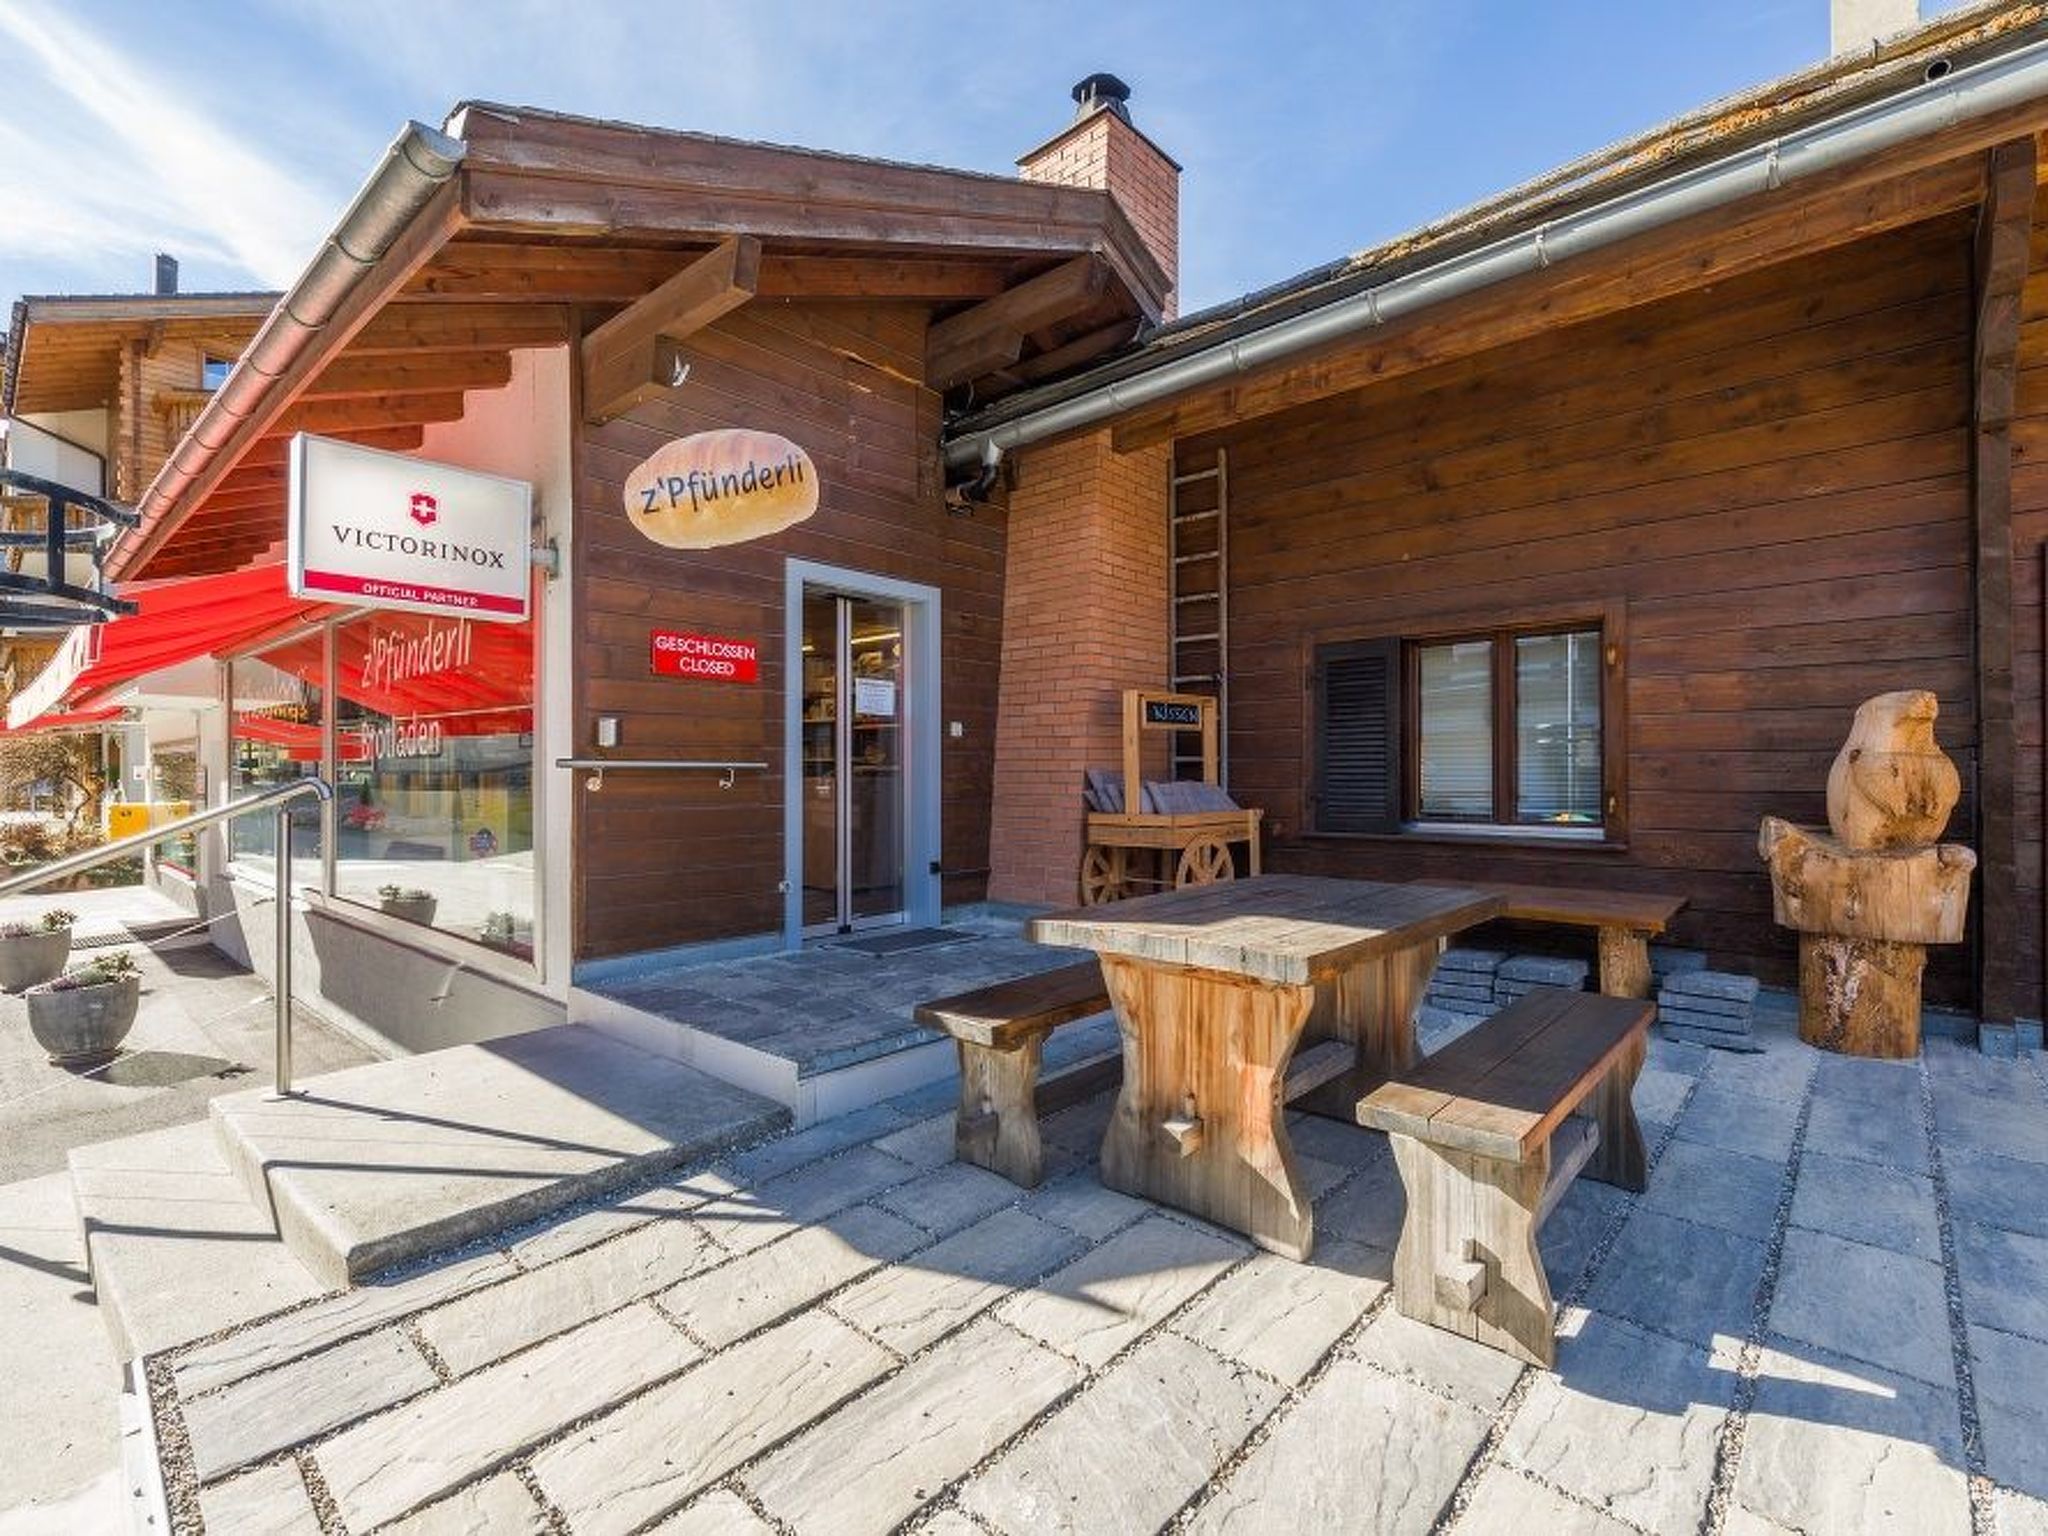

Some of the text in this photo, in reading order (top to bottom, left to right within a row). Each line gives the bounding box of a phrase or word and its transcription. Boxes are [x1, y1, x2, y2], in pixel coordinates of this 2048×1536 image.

[641, 454, 804, 514] z'Pfünderli
[332, 525, 504, 568] VICTORINOX
[363, 583, 479, 607] OFFICIAL PARTNER
[361, 616, 472, 695] z'Pfünderli
[656, 636, 756, 660] GESCHLOSSEN
[680, 656, 735, 676] CLOSED
